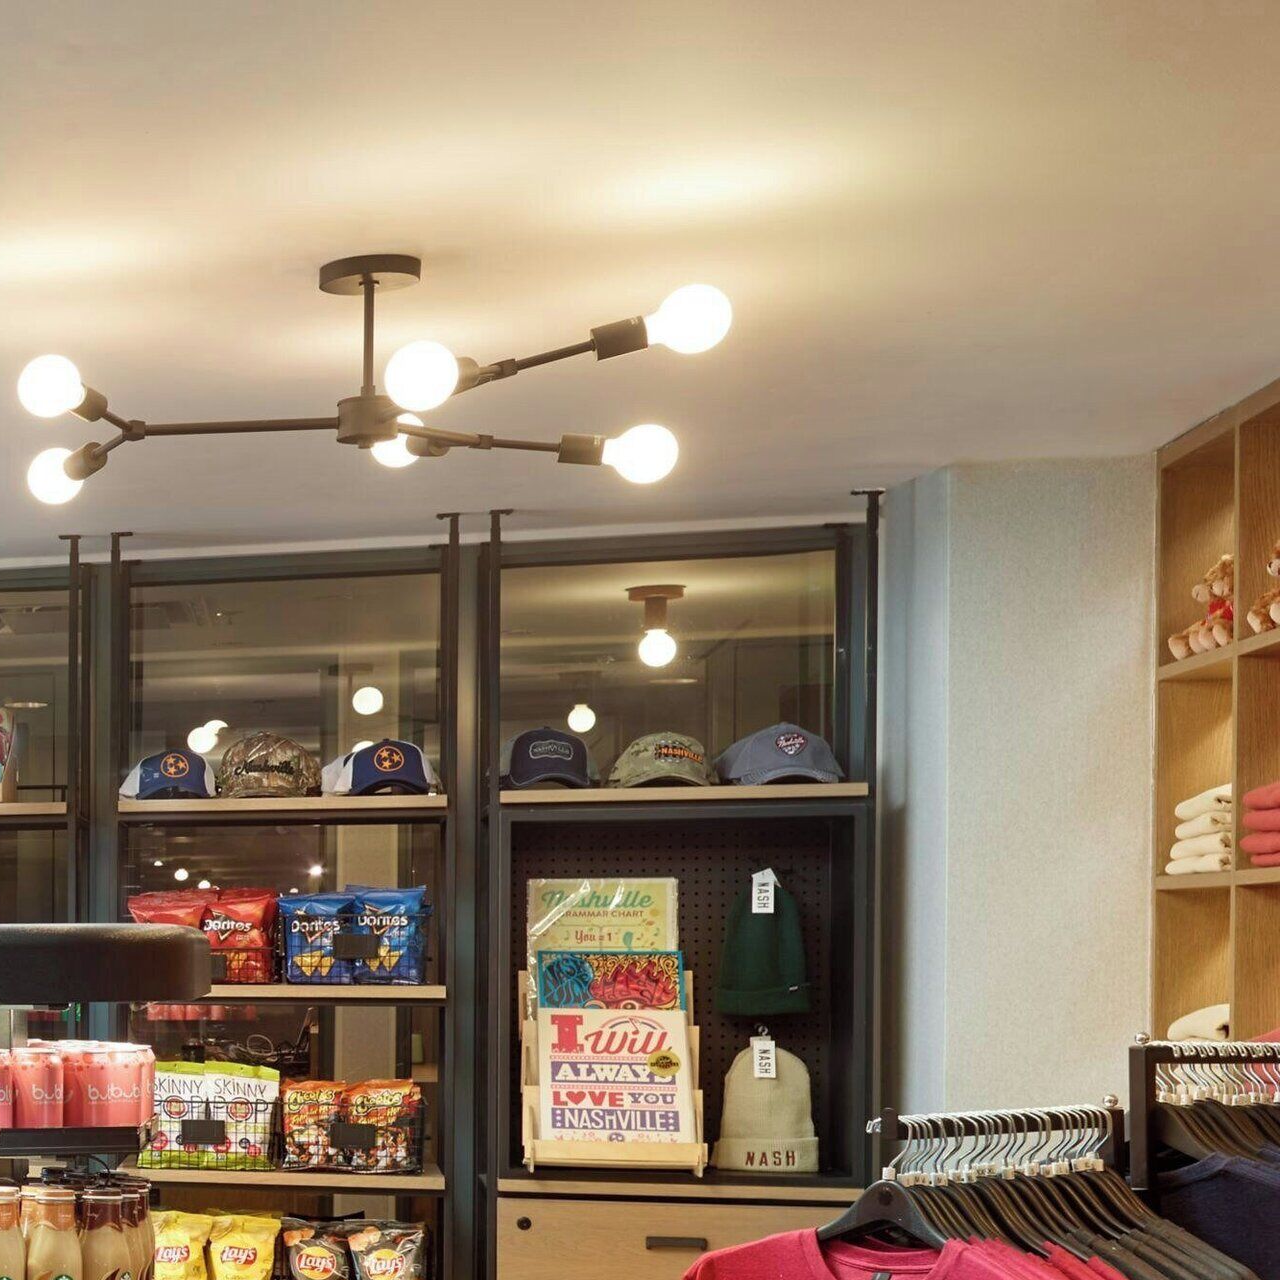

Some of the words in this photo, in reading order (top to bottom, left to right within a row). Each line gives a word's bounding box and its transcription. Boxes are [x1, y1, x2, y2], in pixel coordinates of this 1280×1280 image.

[662, 746, 703, 762] NASHVILLE
[542, 890, 654, 908] Nshvlle
[757, 882, 769, 909] NASH
[204, 920, 252, 932] Doritos
[550, 1014, 584, 1053] I
[758, 1048, 770, 1074] NASH
[555, 1063, 672, 1082] ALWAY
[215, 1078, 267, 1098] SKINNY
[628, 1093, 675, 1104] YOU
[565, 1110, 667, 1130] NASHVILLE
[745, 1150, 796, 1167] NASH
